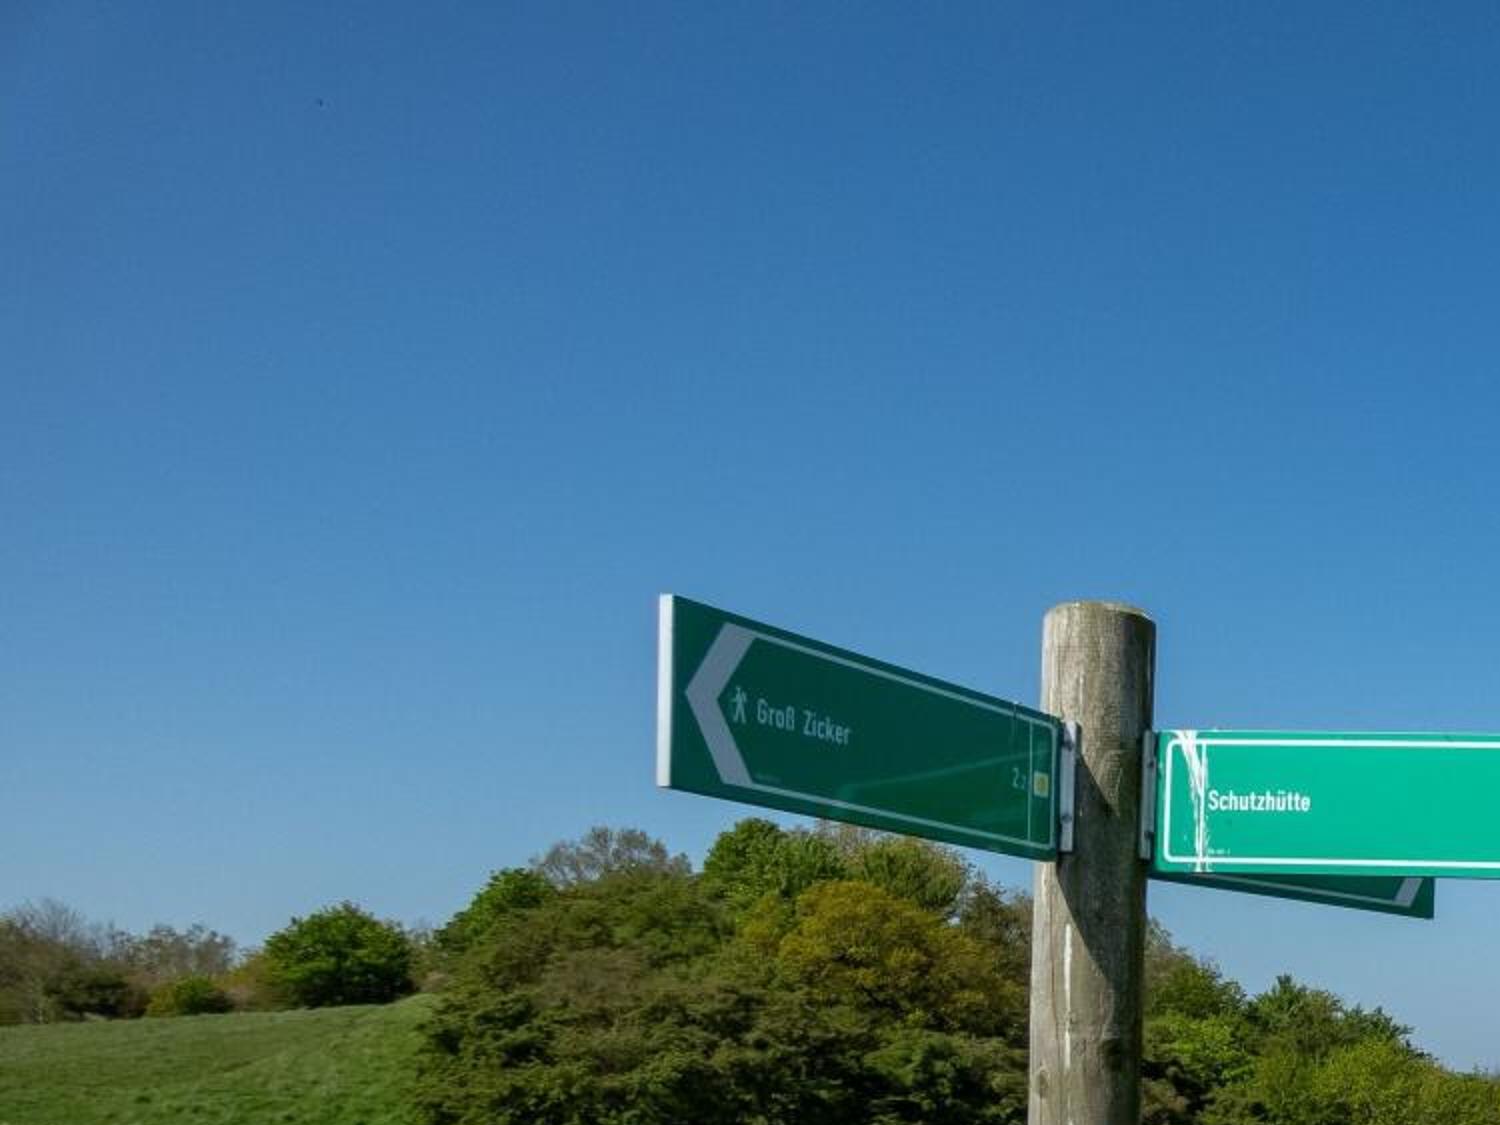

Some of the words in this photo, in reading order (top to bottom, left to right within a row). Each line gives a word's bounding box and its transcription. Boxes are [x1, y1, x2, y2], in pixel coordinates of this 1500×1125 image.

[757, 699, 795, 732] Groß
[803, 709, 851, 745] Zicker
[1207, 790, 1311, 812] Schutzhütte
